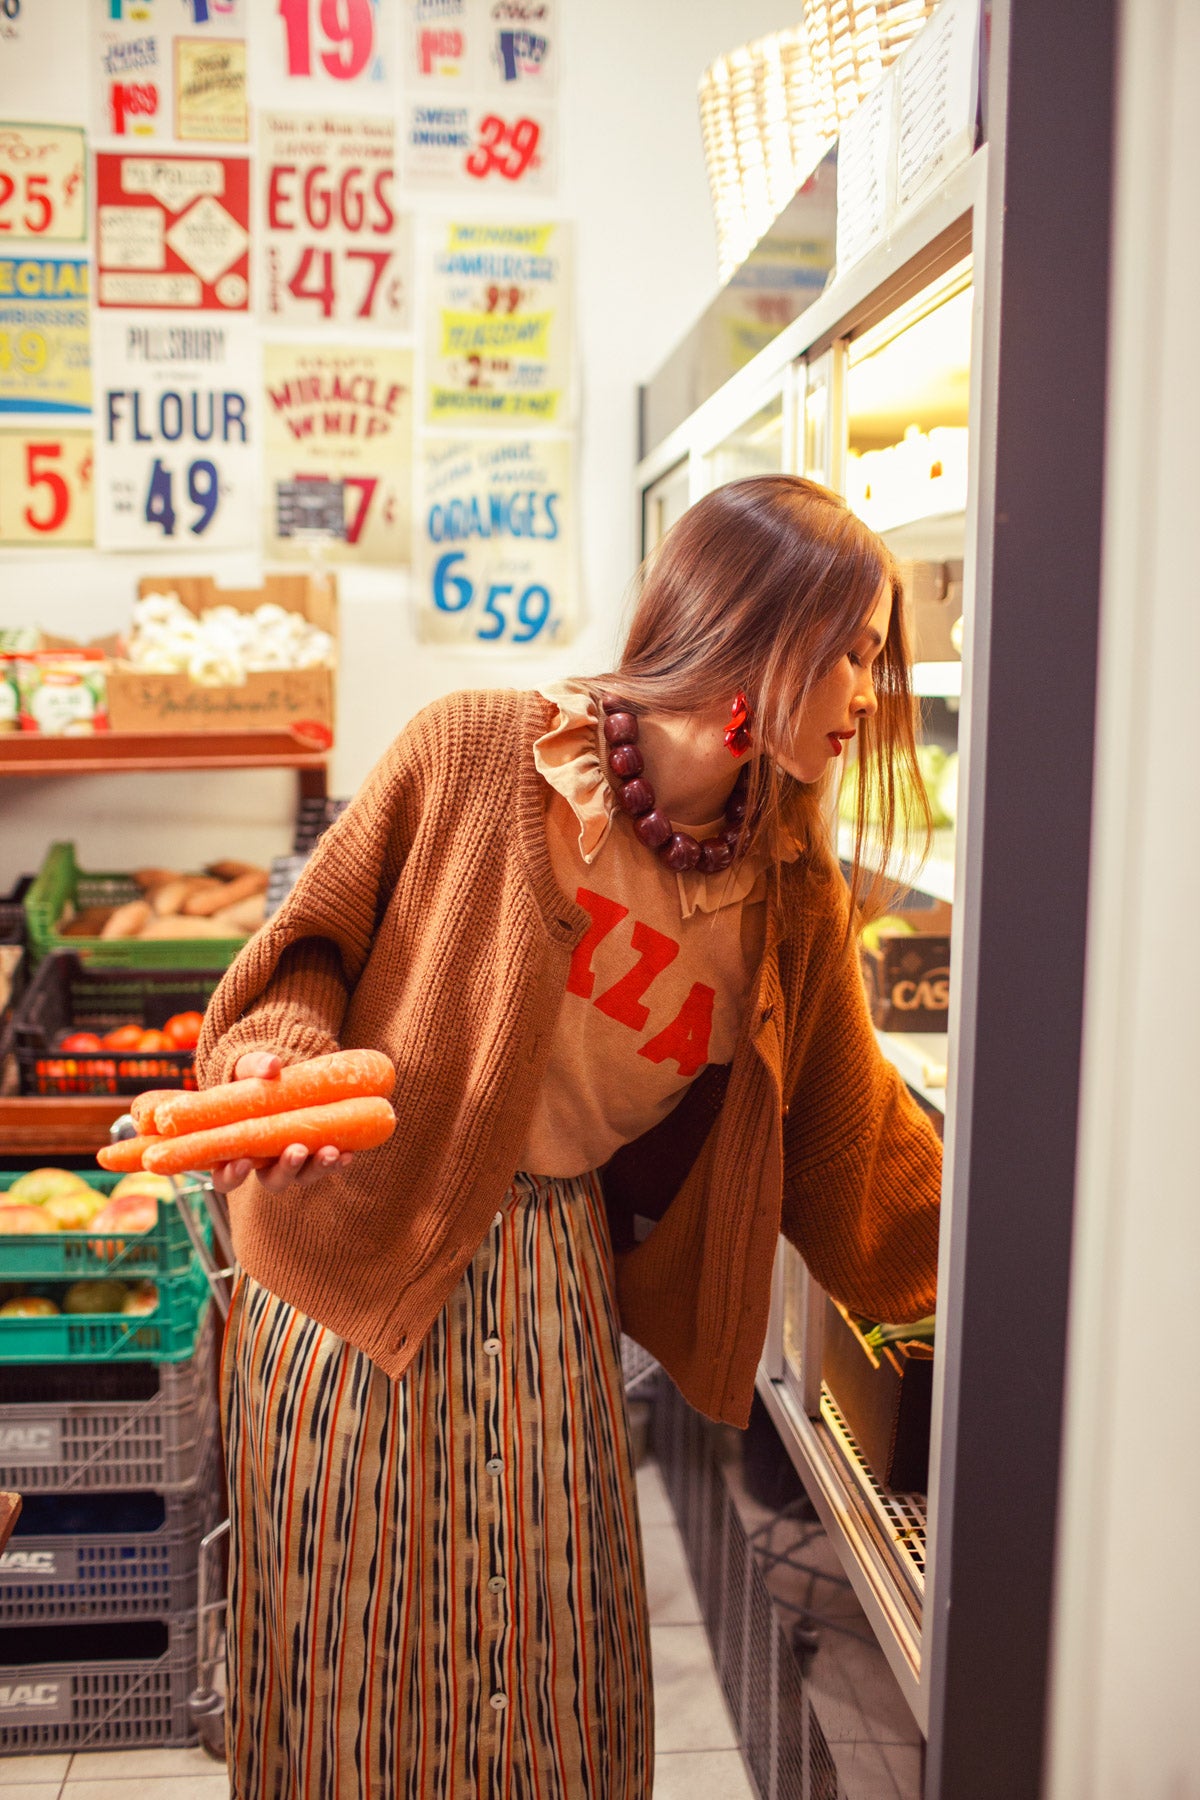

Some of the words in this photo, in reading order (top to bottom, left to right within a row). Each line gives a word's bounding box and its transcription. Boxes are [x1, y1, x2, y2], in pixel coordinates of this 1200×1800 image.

[267, 165, 395, 236] EGGS
[105, 390, 248, 442] FLOUR
[266, 374, 405, 413] MIRACLE
[287, 412, 392, 440] WHIP
[429, 490, 560, 543] ORANGES
[431, 551, 474, 614] 6
